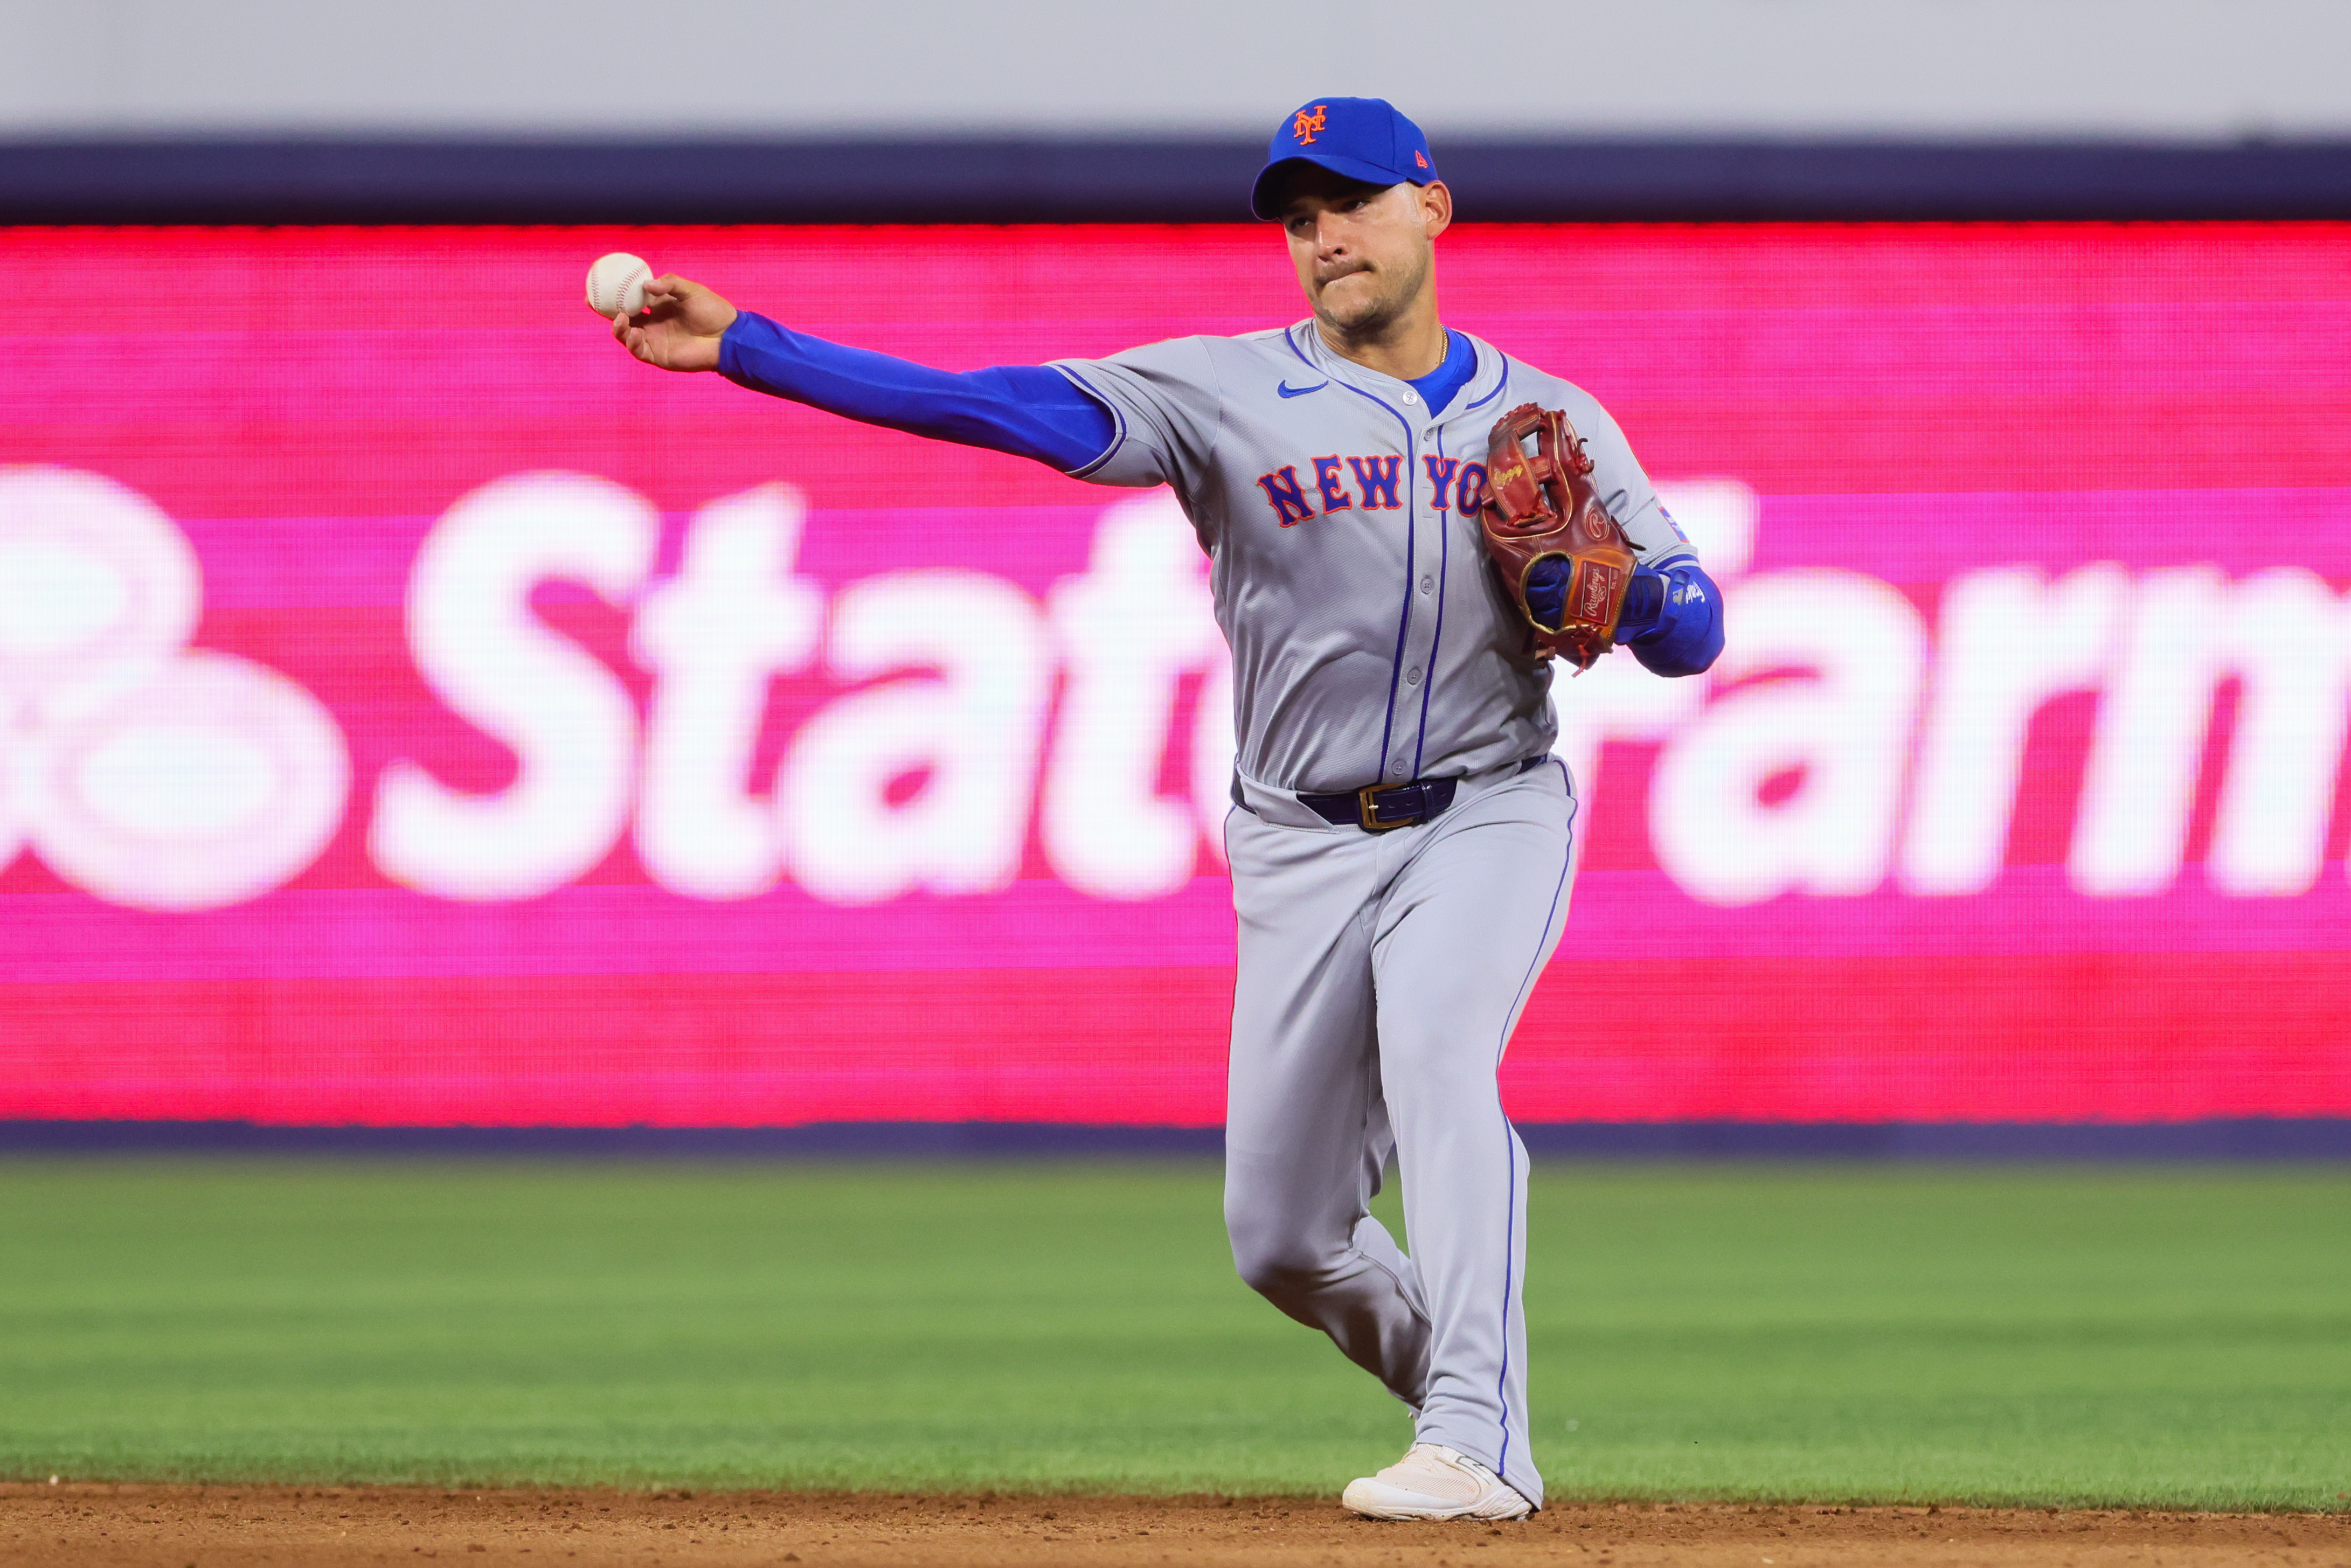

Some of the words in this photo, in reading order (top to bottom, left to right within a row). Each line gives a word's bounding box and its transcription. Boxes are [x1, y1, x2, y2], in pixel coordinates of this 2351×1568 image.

[1256, 453, 1403, 528] NEW
[1584, 568, 1605, 616] Rawlings
[369, 469, 1234, 905] Stat
